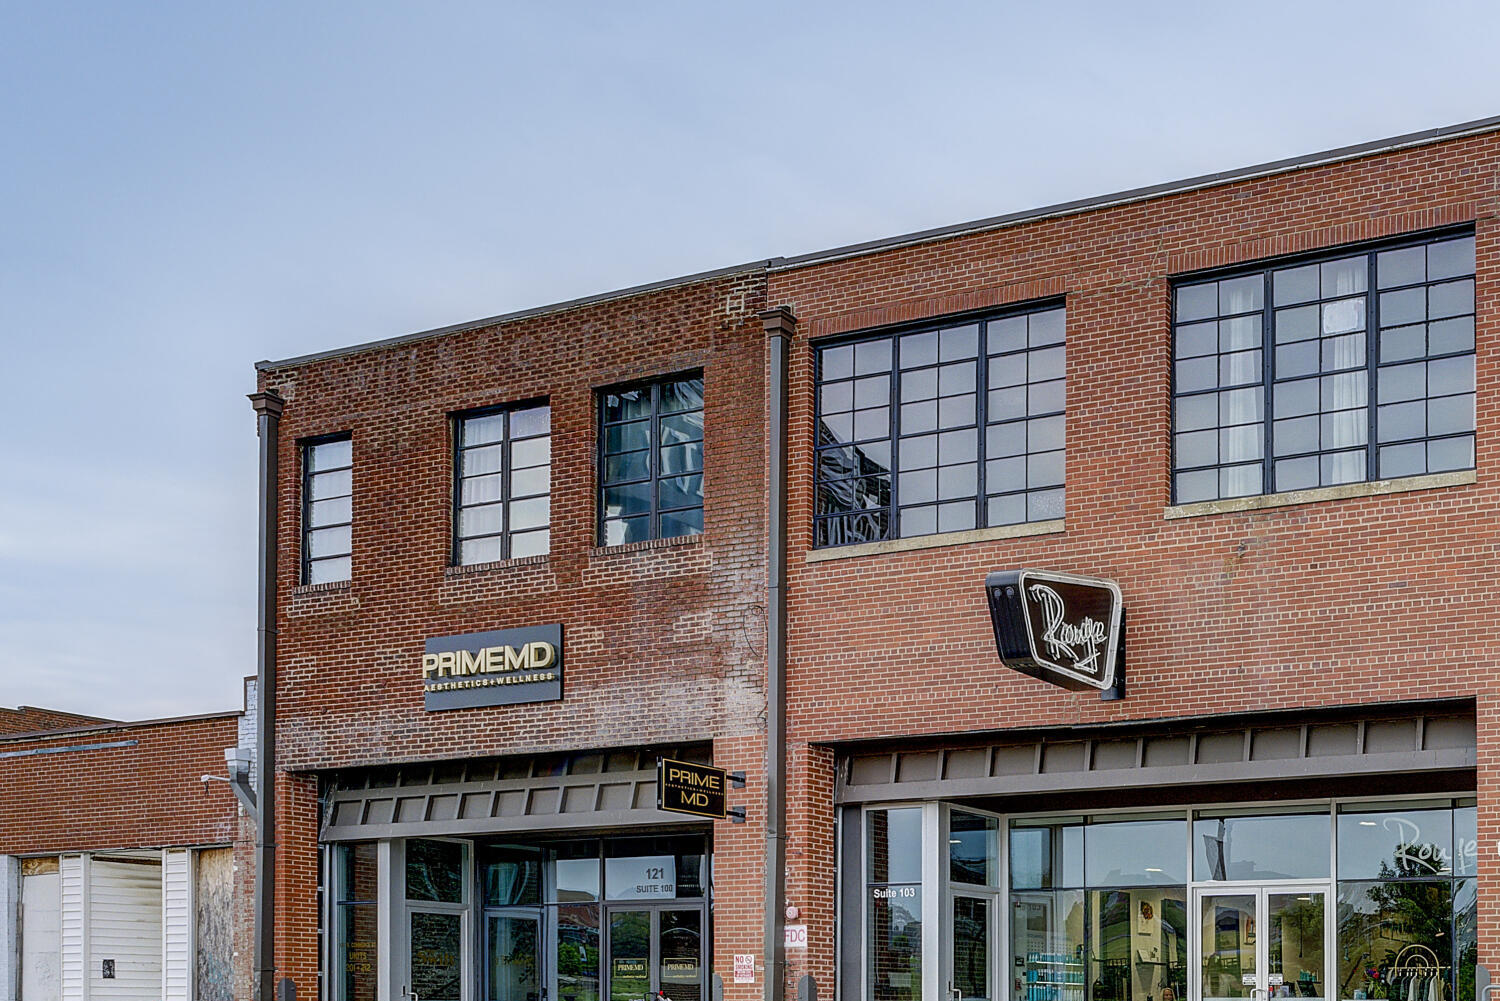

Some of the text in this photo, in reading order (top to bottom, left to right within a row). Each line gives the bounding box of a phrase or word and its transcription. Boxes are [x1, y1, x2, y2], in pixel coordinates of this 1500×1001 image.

[422, 641, 556, 679] PRIMEMD
[669, 768, 720, 789] PRIME
[681, 791, 709, 807] MD
[646, 867, 664, 880] 121
[636, 884, 673, 893] SUITE 100
[873, 887, 916, 898] Suite 103
[784, 929, 806, 943] FDC
[735, 955, 744, 964] NO
